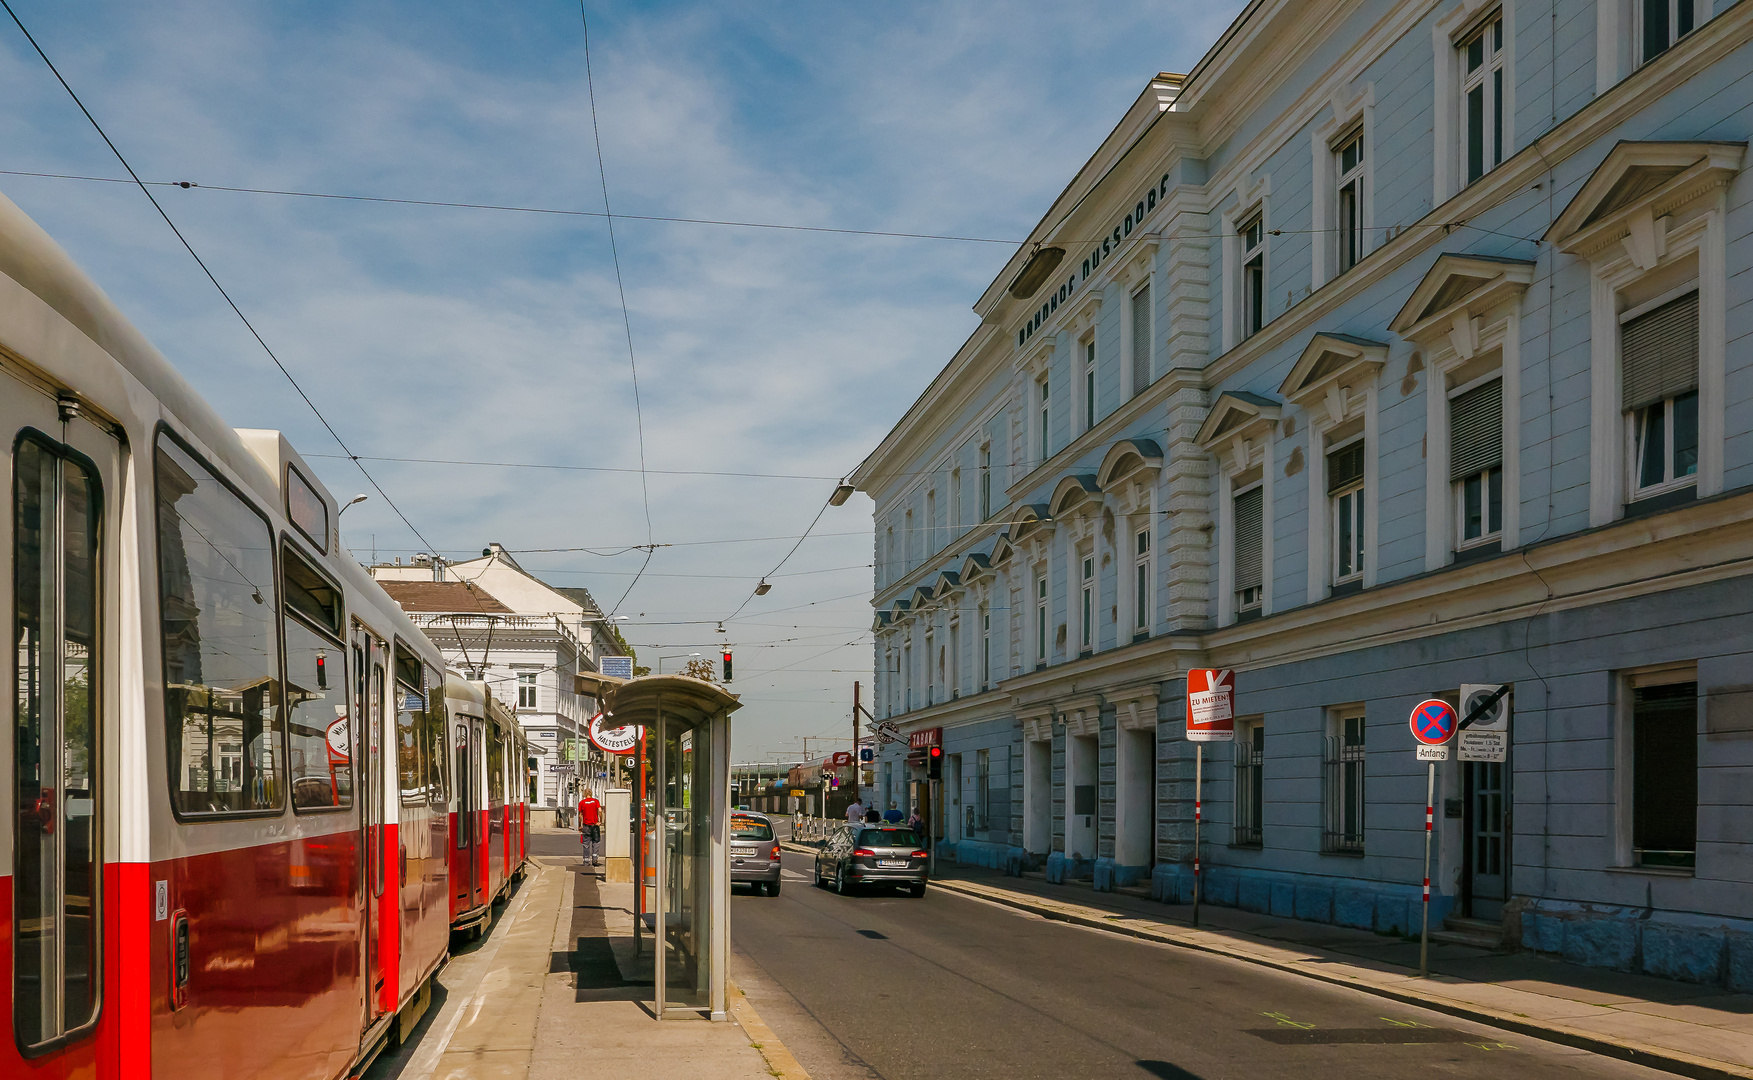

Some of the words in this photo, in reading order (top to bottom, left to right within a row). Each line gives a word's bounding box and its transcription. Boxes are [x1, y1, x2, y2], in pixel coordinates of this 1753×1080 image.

[1019, 274, 1075, 347] BAHNHOF
[1082, 173, 1169, 281] NUSSDORF
[1192, 698, 1200, 706] ZU
[1202, 694, 1229, 705] MIETEN!
[597, 734, 636, 748] HALTESTELLE
[1420, 748, 1445, 759] Anfang
[627, 759, 635, 767] D
